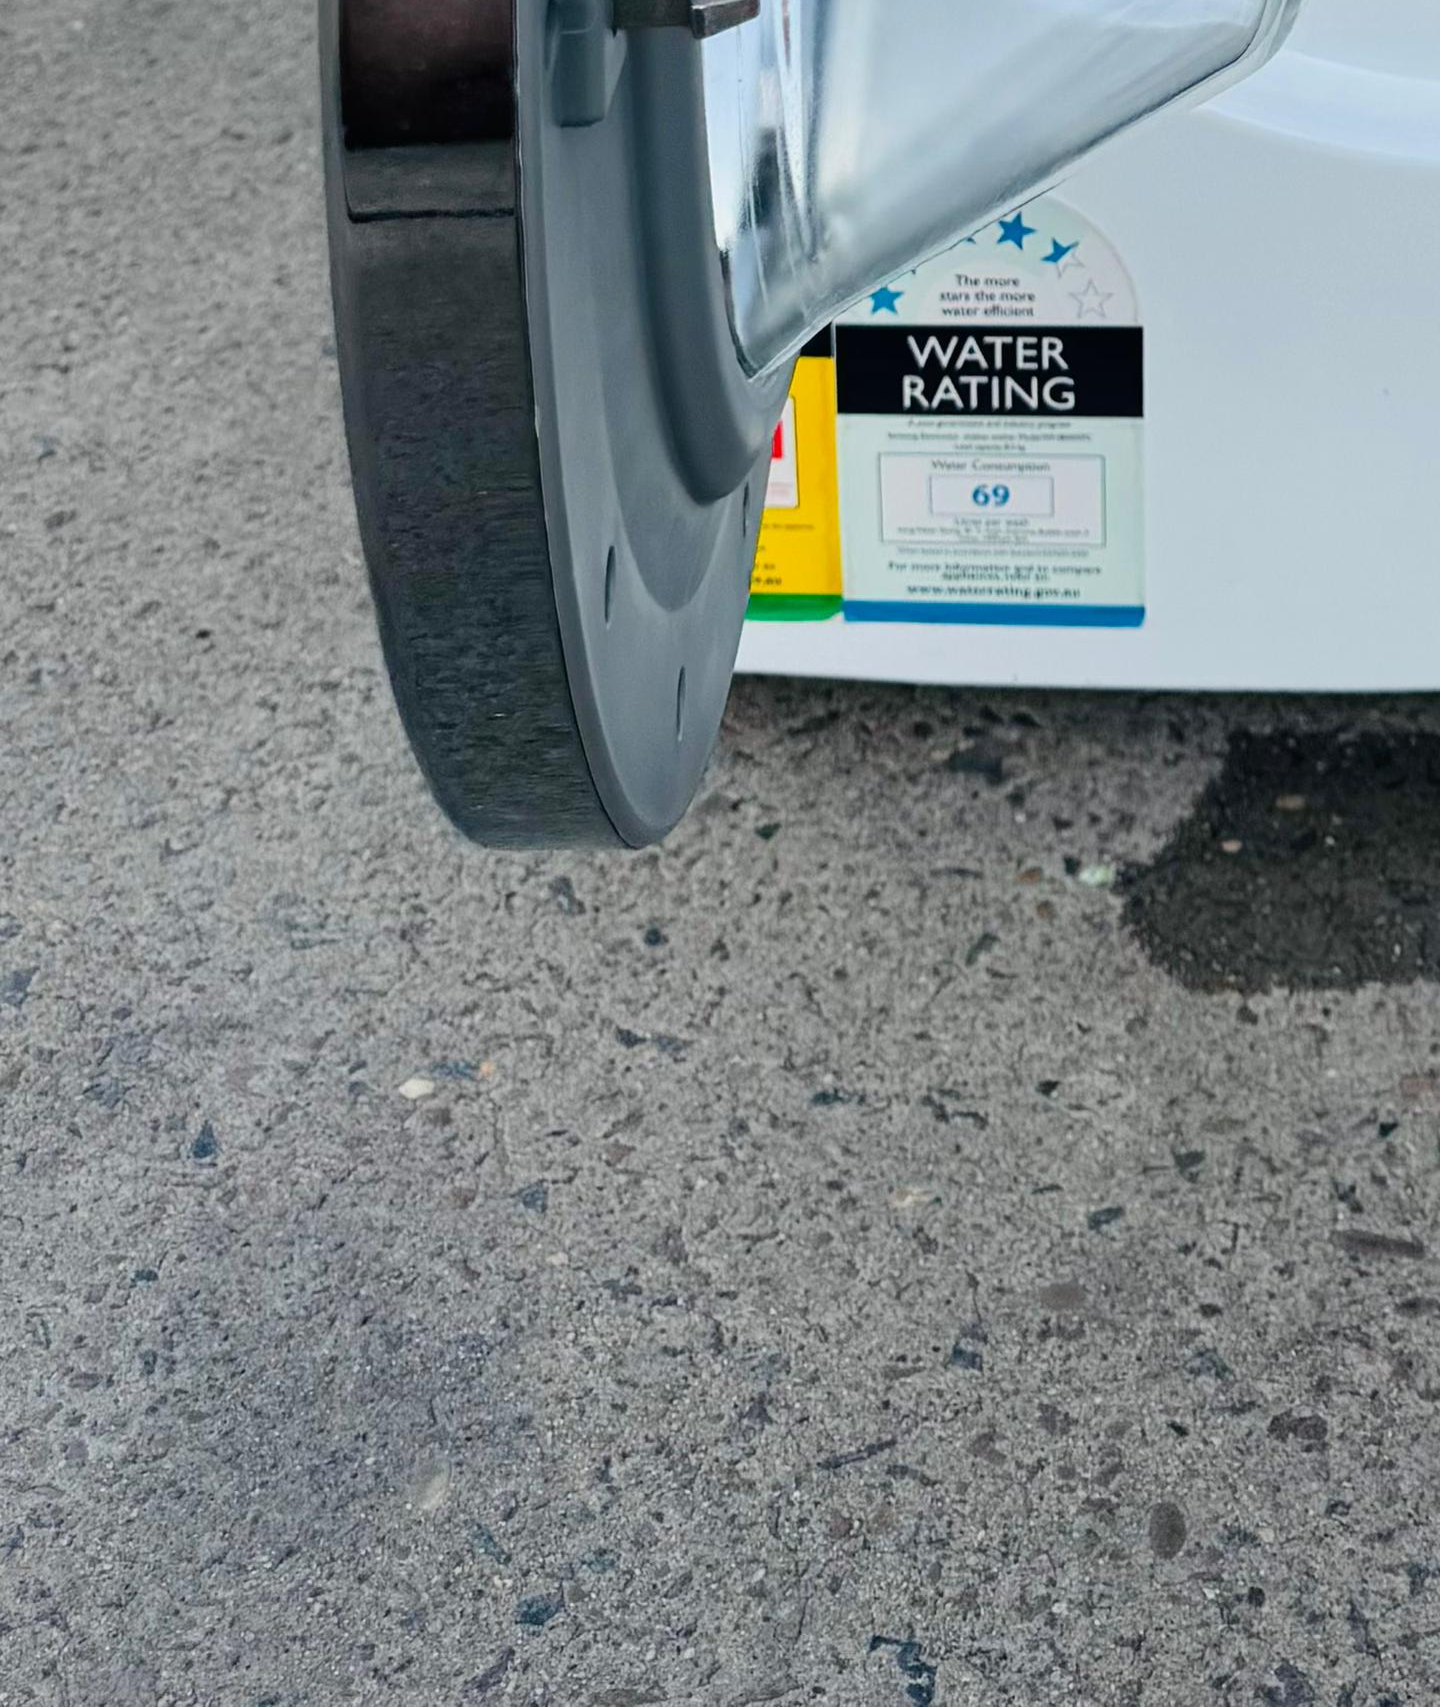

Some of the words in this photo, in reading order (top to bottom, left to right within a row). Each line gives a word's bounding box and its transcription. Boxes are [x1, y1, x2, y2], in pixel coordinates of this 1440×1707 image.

[956, 274, 980, 286] The
[985, 277, 1019, 287] more
[940, 291, 970, 301] stars
[975, 290, 996, 301] the
[1000, 293, 1035, 302] more
[943, 307, 977, 317] water
[984, 305, 1034, 317] efficient
[908, 336, 1069, 371] WATER
[902, 375, 1076, 410] RATING
[972, 484, 1010, 507] 69
